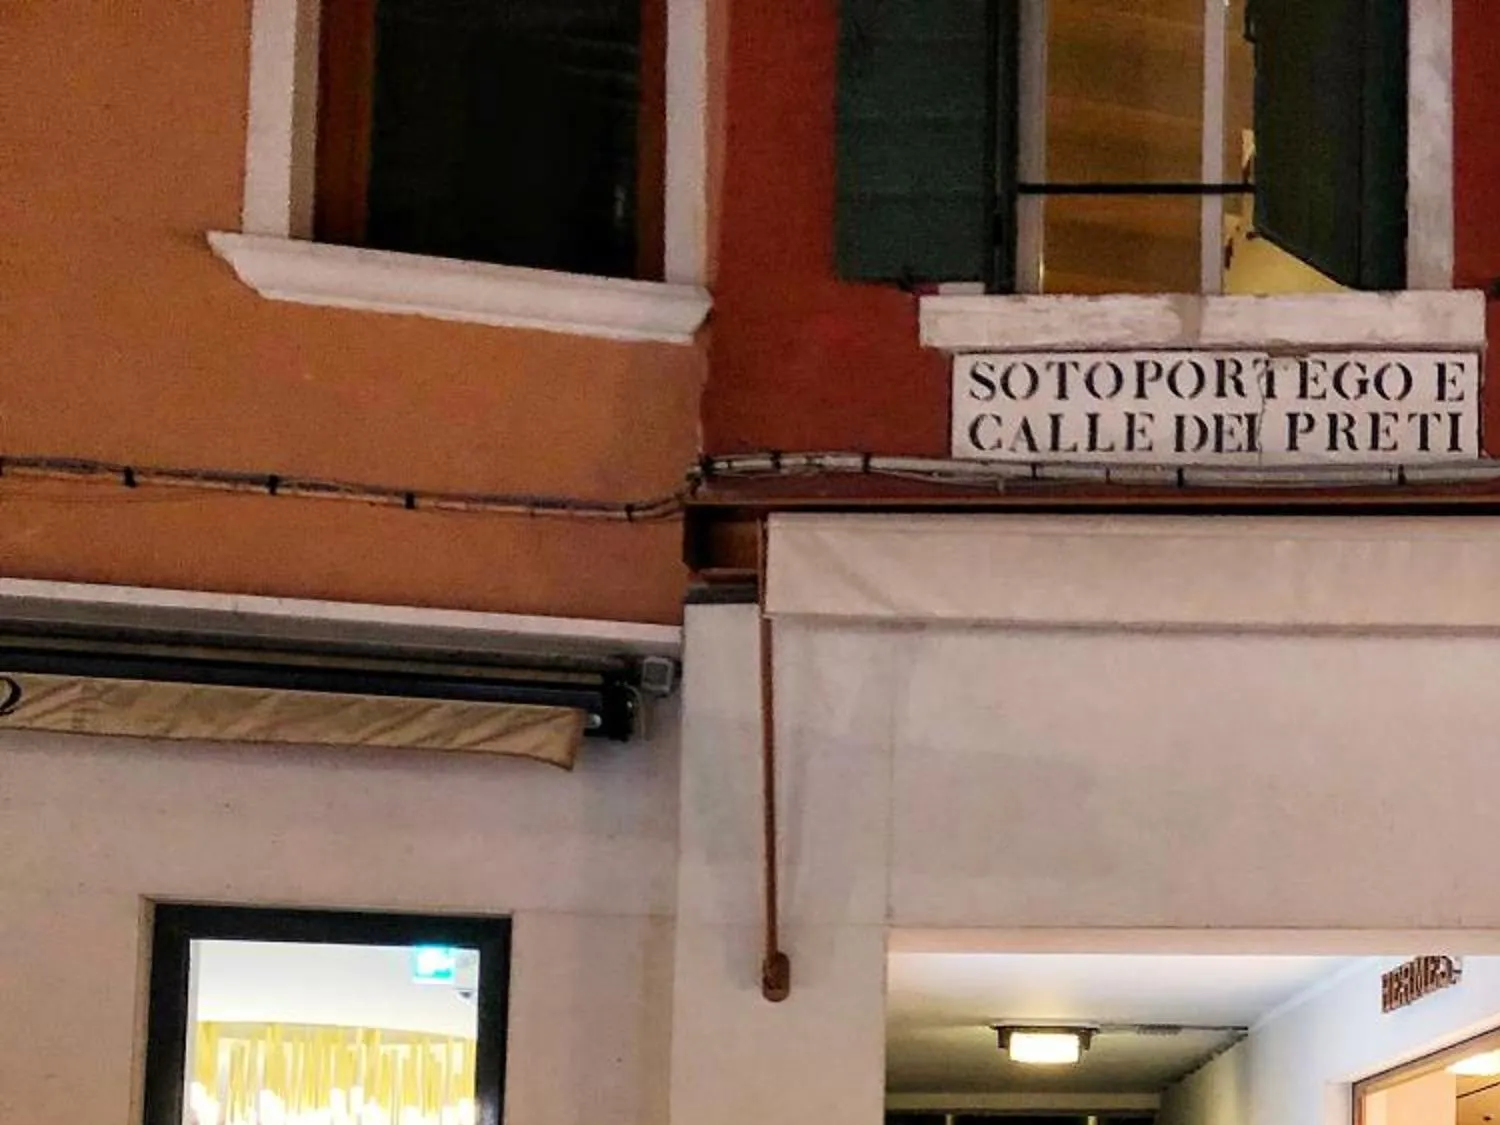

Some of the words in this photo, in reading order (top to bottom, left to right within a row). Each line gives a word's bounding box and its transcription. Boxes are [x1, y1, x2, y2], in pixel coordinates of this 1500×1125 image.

[968, 357, 1414, 403] SOTOPORTEGO
[1435, 360, 1465, 403] E
[968, 411, 1155, 453] CALLE
[1173, 412, 1259, 454] DEI
[1285, 411, 1464, 453] PRETI
